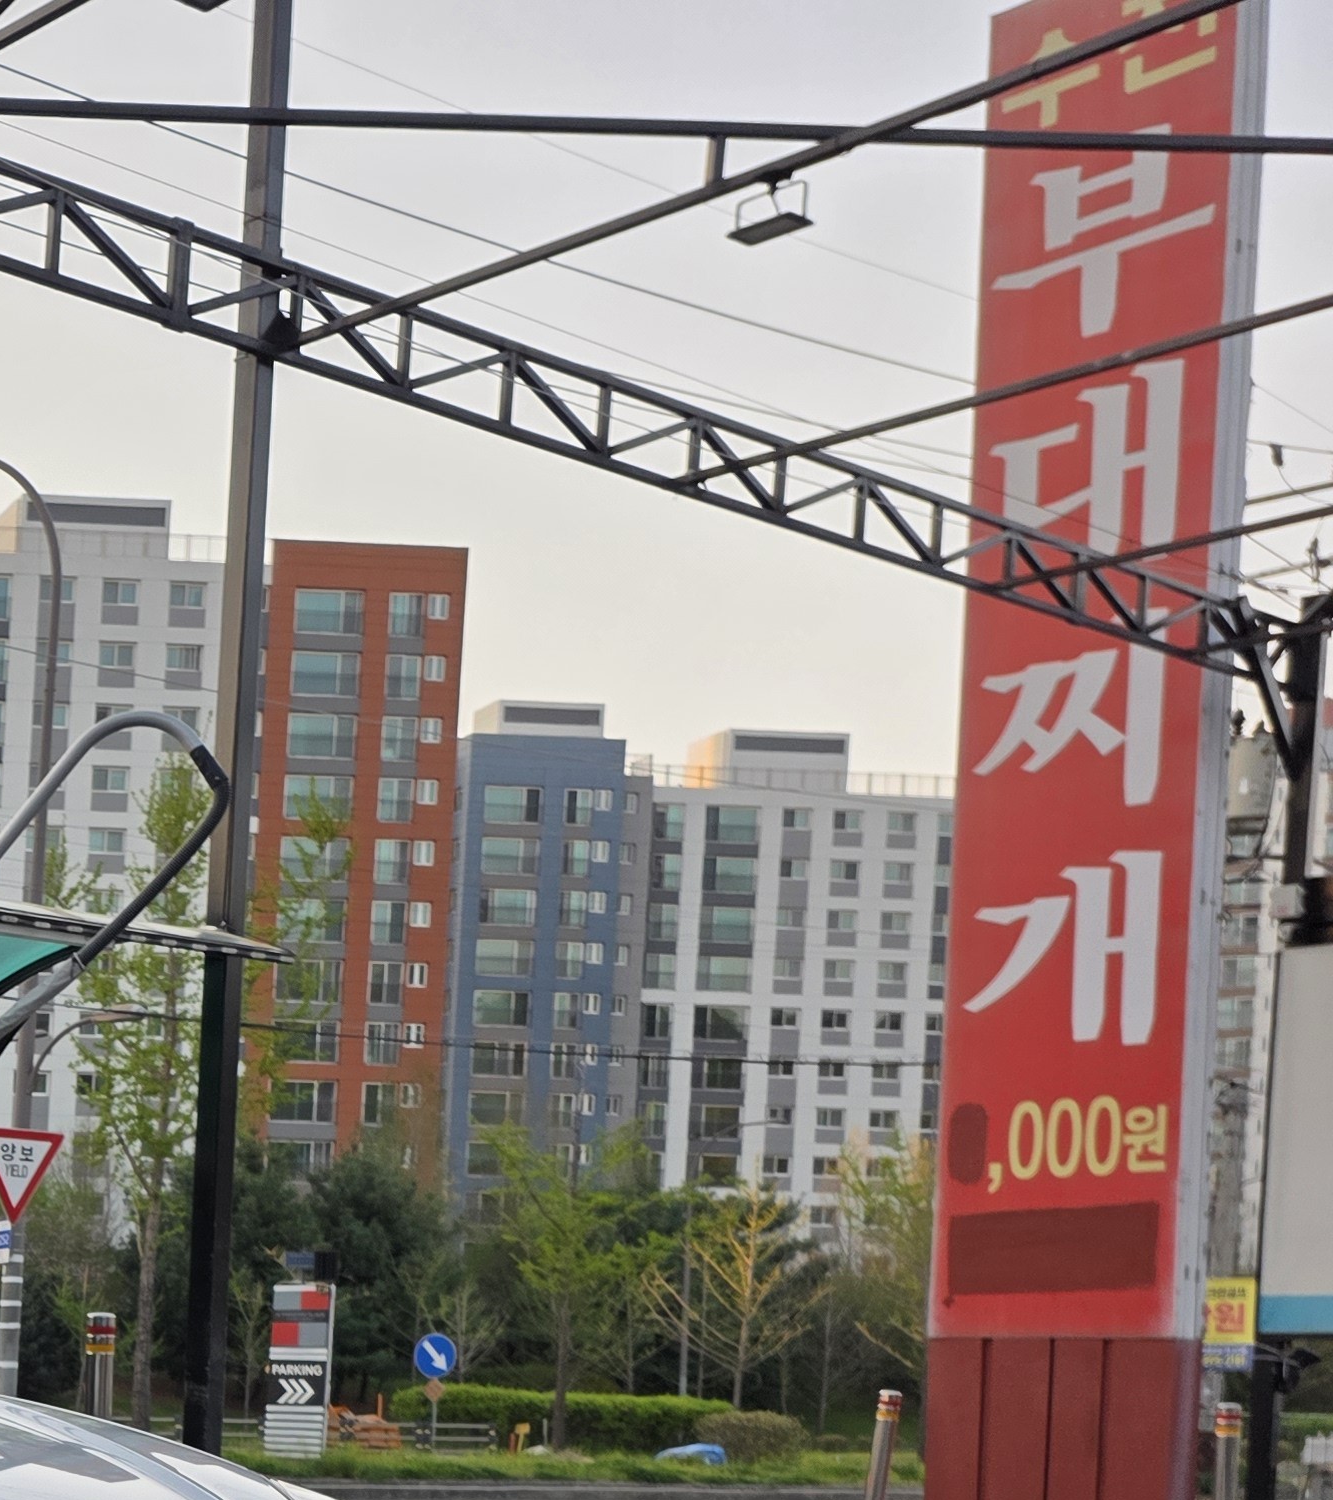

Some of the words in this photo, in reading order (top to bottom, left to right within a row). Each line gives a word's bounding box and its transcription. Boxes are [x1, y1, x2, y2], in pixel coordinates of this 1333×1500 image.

[962, 123, 1216, 1047] 부대찌개
[0, 1143, 35, 1162] 양보
[4, 1164, 29, 1178] YIELD
[271, 1363, 323, 1377] PARKING
